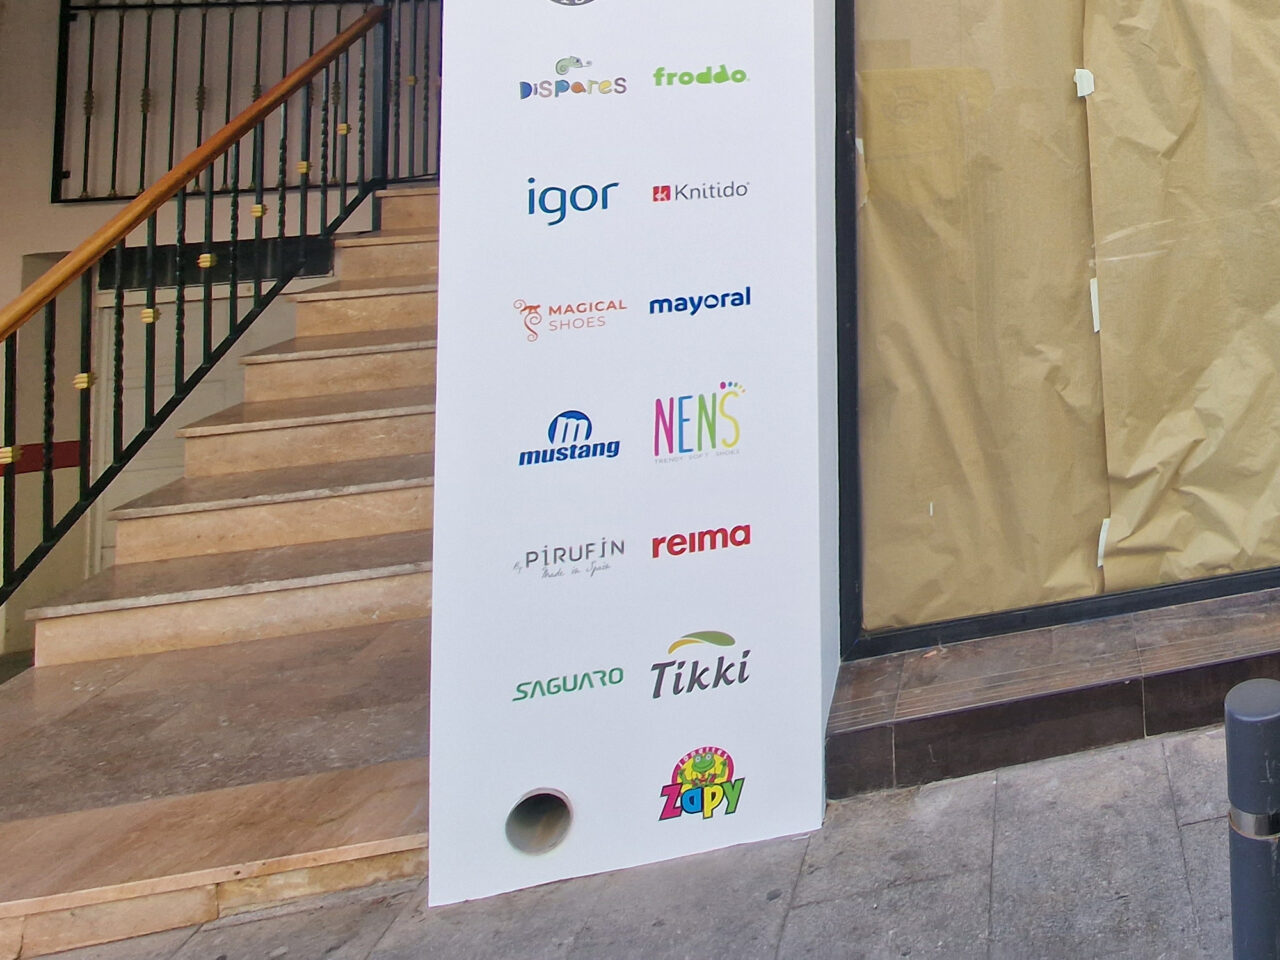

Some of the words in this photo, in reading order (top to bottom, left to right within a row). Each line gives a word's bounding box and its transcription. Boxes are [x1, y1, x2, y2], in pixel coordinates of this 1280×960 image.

[653, 64, 747, 86] froddo
[527, 177, 620, 226] igor
[675, 180, 748, 200] Knitido
[548, 299, 627, 316] MAGICAL
[649, 286, 751, 316] mayoral
[548, 315, 606, 332] SHOES
[654, 390, 740, 457] NENS
[518, 440, 621, 466] mustang
[651, 524, 752, 559] reima
[512, 667, 625, 702] SAGUARO
[651, 649, 752, 699] Tikki
